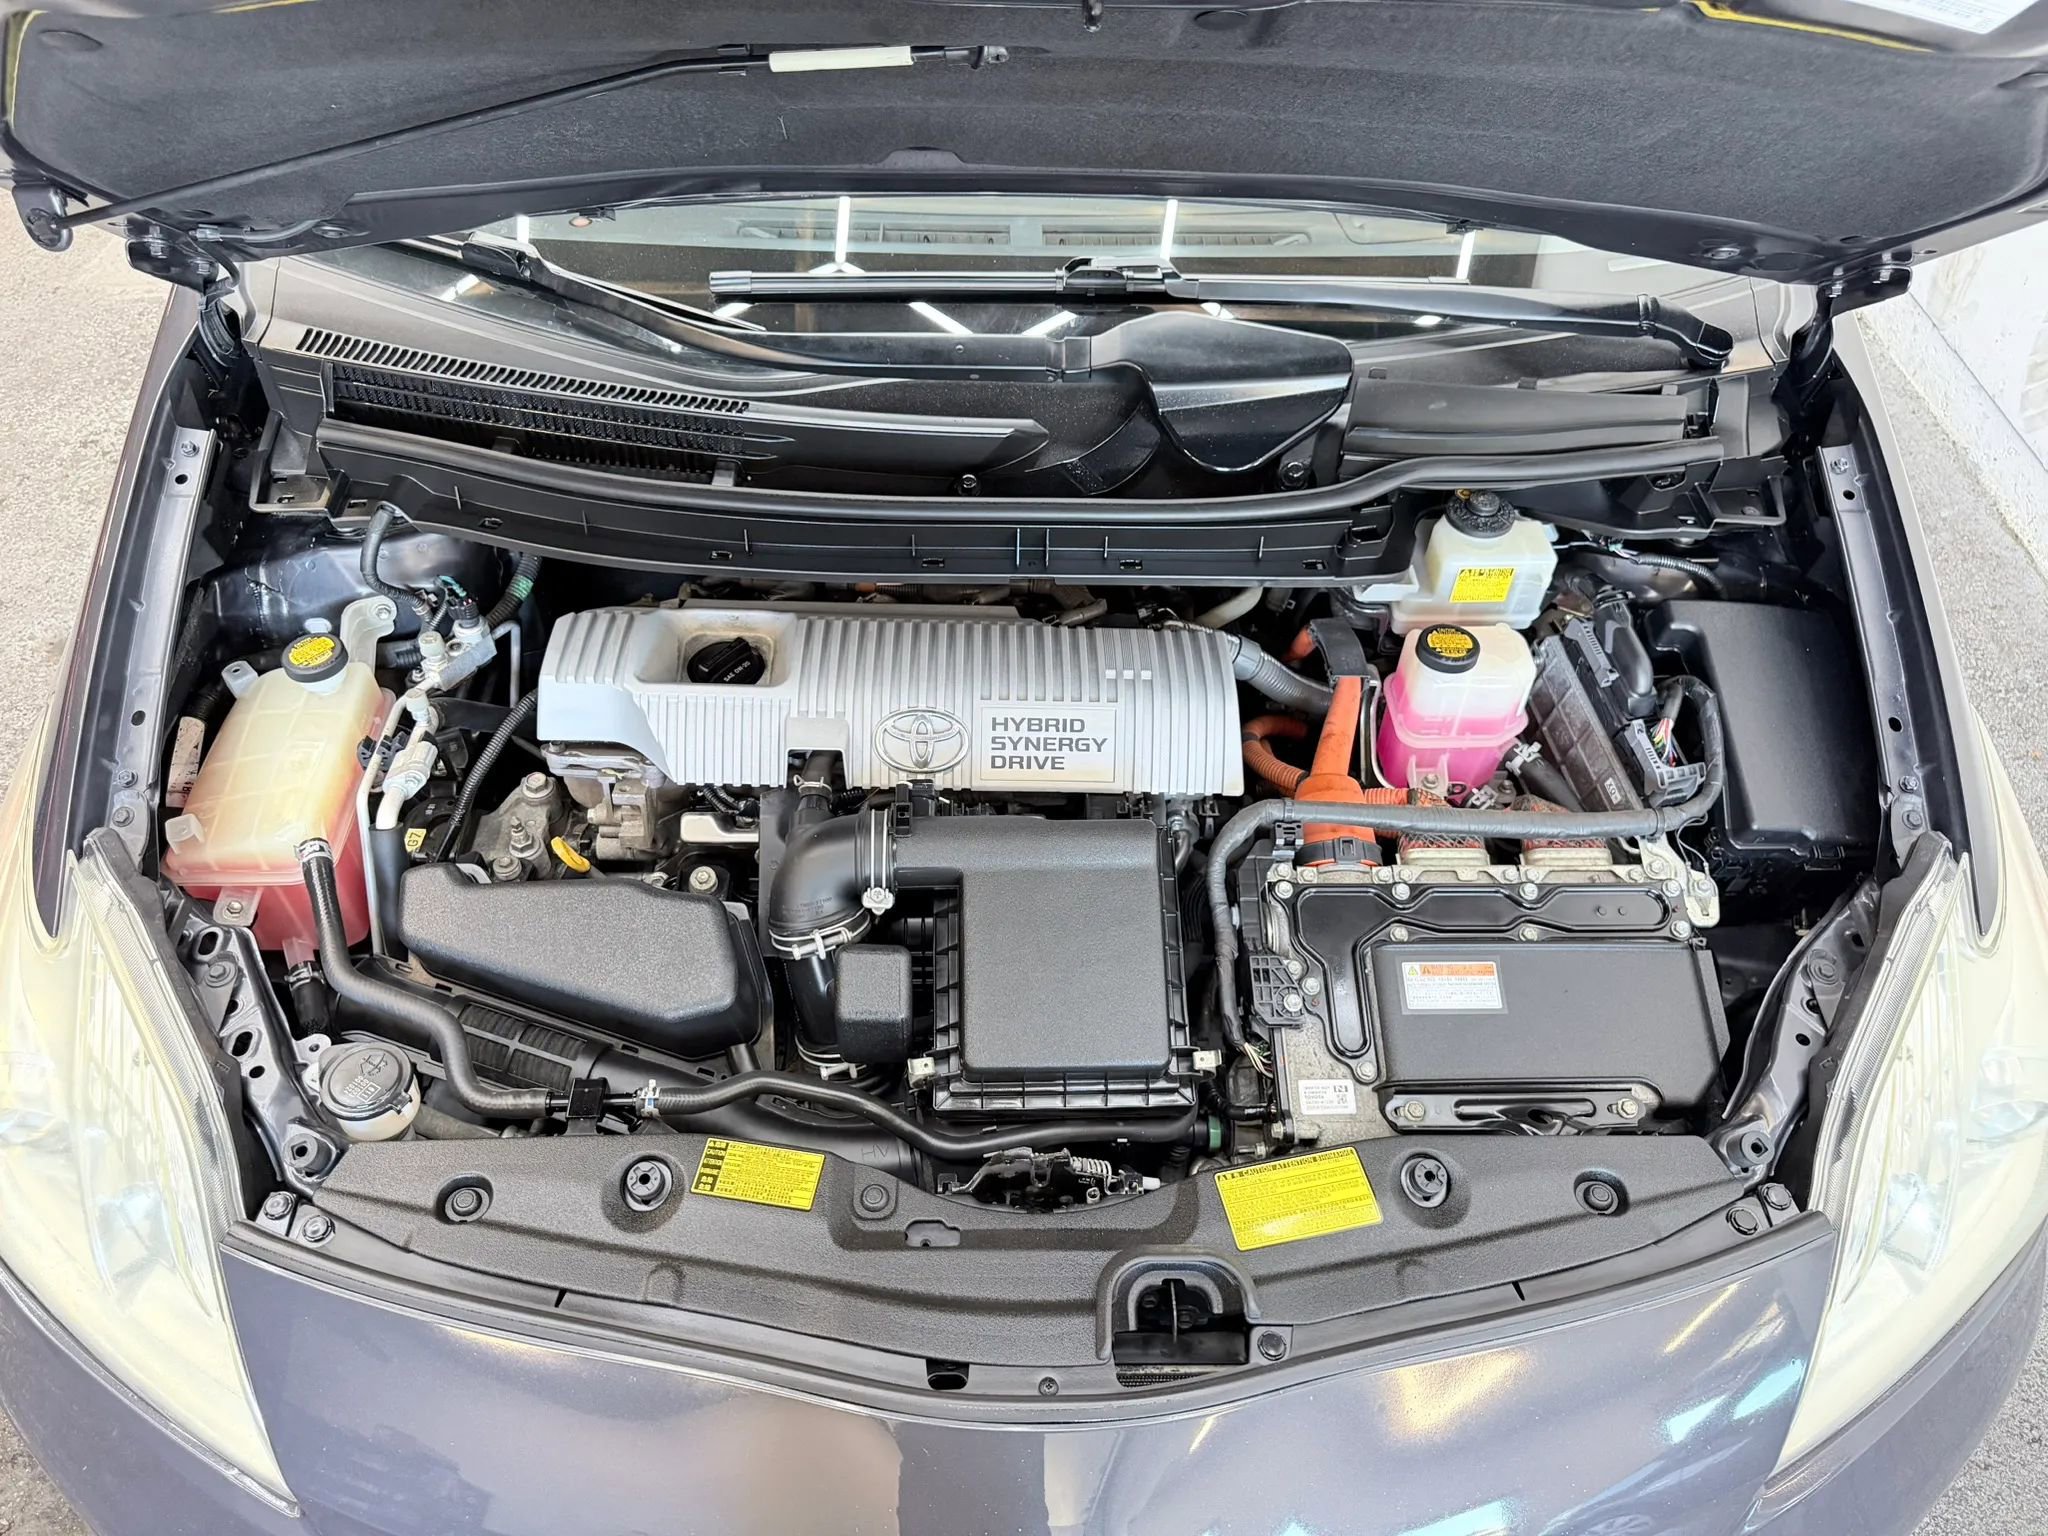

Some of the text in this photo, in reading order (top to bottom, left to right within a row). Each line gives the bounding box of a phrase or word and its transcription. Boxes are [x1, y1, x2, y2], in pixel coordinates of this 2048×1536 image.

[991, 717, 1085, 733] HYBRID
[990, 736, 1108, 752] SYNERGY
[990, 755, 1065, 770] DRIVE
[406, 831, 421, 846] G7
[1243, 1164, 1273, 1177] CAUTION
[1277, 1156, 1315, 1171] ATTENTION
